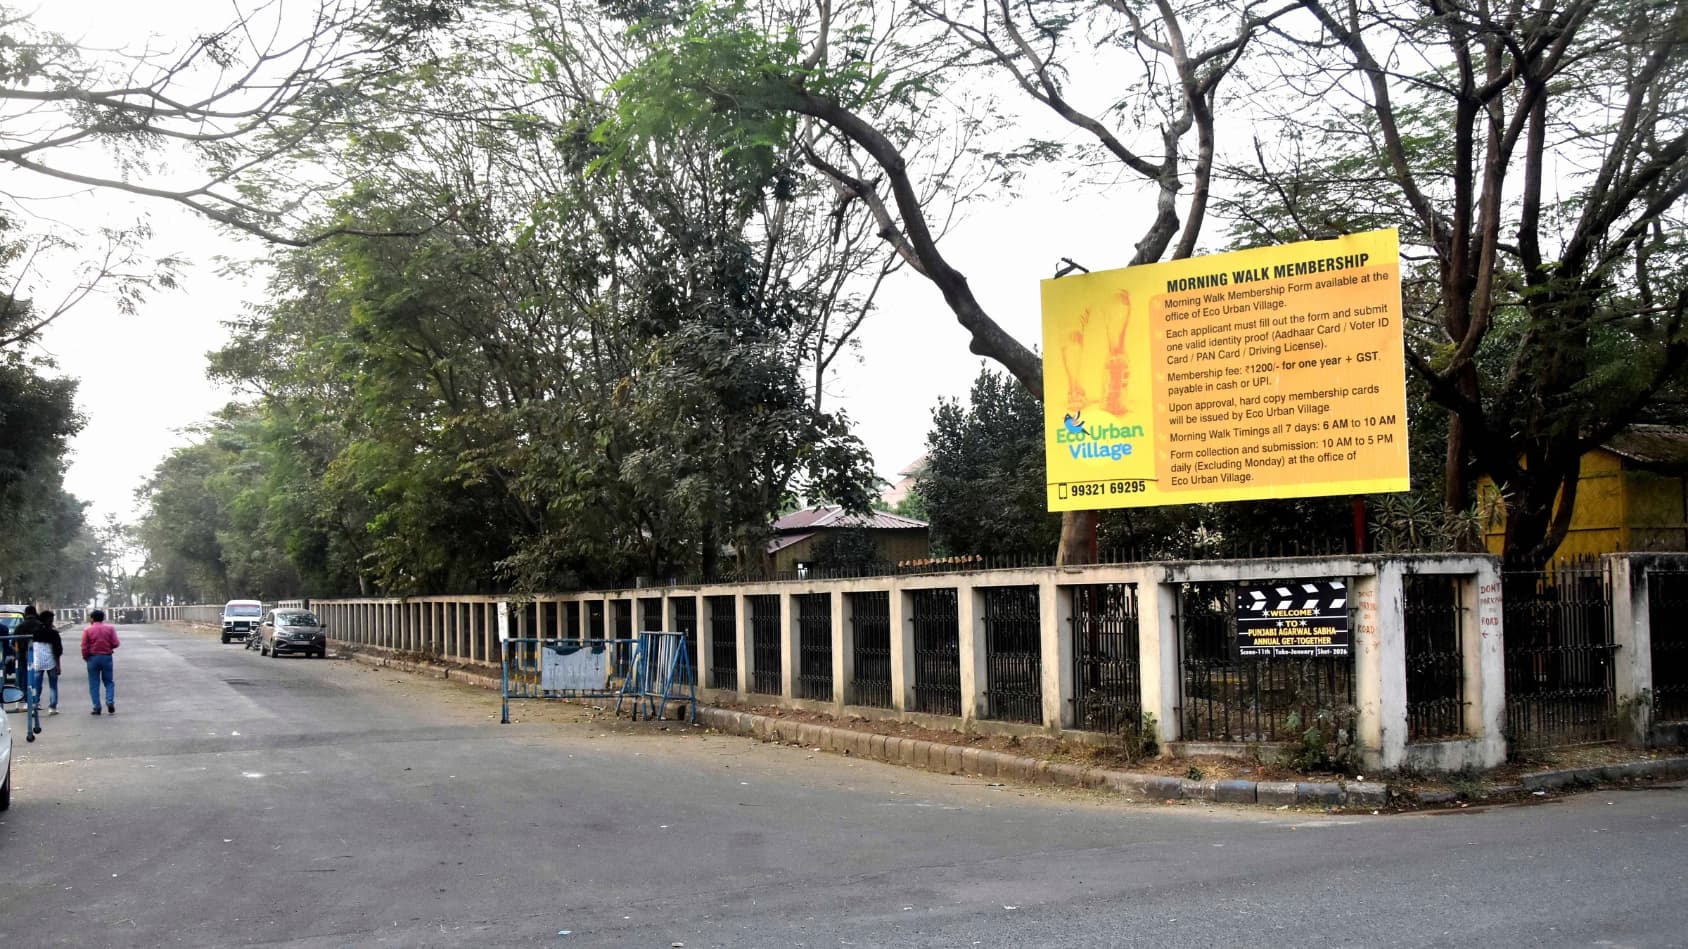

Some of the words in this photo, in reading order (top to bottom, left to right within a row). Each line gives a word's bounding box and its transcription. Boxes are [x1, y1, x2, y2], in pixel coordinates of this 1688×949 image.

[1167, 273, 1227, 292] MORNING
[1232, 268, 1270, 283] WALK
[1274, 253, 1369, 279] MEMBERSHIP
[1165, 295, 1201, 309] Morning
[1203, 292, 1225, 302] Walk
[1228, 285, 1285, 300] Membership
[1288, 281, 1312, 292] Form
[1315, 275, 1358, 289] available
[1361, 274, 1370, 283] at
[1373, 272, 1388, 281] the
[1165, 311, 1189, 322] office
[1192, 309, 1201, 318] of
[1203, 306, 1220, 317] Eco
[1222, 303, 1250, 314] Urban
[1253, 299, 1287, 310] Village.
[1166, 328, 1188, 339] Each
[1191, 324, 1231, 337] applicant
[1234, 321, 1256, 330] must
[1259, 318, 1270, 327] fill
[1273, 317, 1287, 326] out
[1290, 315, 1305, 324] the
[1307, 312, 1329, 321] form
[1332, 308, 1350, 318] and
[1354, 304, 1388, 316] submit
[1166, 342, 1183, 352] one
[1185, 338, 1206, 349] valid
[1209, 334, 1242, 348] identity
[1244, 331, 1269, 344] proof
[1272, 327, 1314, 341] (Aadhaar
[1317, 324, 1340, 334] Card
[1350, 321, 1375, 331] Voter
[1379, 318, 1389, 328] ID
[1167, 354, 1188, 365] Card
[1196, 351, 1215, 361] PAN
[1218, 348, 1240, 359] Card
[1249, 344, 1281, 356] Driving
[1284, 340, 1326, 352] License).
[1168, 369, 1222, 382] Membership
[1225, 367, 1242, 376] fee:
[1282, 361, 1296, 370] for
[1299, 359, 1317, 368] one
[1320, 356, 1341, 368] year
[1168, 384, 1203, 396] payable
[1205, 383, 1213, 392] in
[1216, 381, 1237, 390] cash
[1241, 380, 1250, 388] or
[1169, 402, 1193, 414] Upon
[1195, 399, 1237, 412] approval,
[1240, 396, 1260, 406] hard
[1263, 395, 1286, 405] copy
[1289, 389, 1349, 402] membership
[1352, 385, 1379, 395] cards
[1169, 416, 1183, 425] will
[1186, 414, 1197, 423] be
[1200, 412, 1229, 423] issued
[1232, 411, 1243, 421] by
[1246, 409, 1263, 419] Eco
[1266, 406, 1295, 416] Urban
[1091, 424, 1144, 440] Urban
[1170, 431, 1206, 443] Morning
[1209, 429, 1231, 439] Walk
[1233, 425, 1270, 438] Timings
[1273, 424, 1283, 434] all
[1286, 424, 1291, 433] 7
[1294, 422, 1320, 434] days:
[1323, 421, 1329, 430] 6
[1332, 419, 1348, 429] AM
[1352, 419, 1361, 428] to
[1364, 418, 1376, 427] 10
[1379, 415, 1396, 425] AM
[1069, 442, 1131, 460] Village
[1170, 449, 1193, 459] Form
[1196, 446, 1239, 457] collection
[1242, 445, 1259, 454] and
[1262, 441, 1318, 452] submission:
[1323, 439, 1333, 448] 10
[1336, 437, 1352, 447] AM
[1355, 437, 1364, 446] to
[1368, 436, 1374, 445] 5
[1377, 434, 1393, 443] PM
[1171, 462, 1191, 474] daily
[1195, 458, 1242, 471] (Excluding
[1245, 455, 1284, 467] Monday)
[1288, 456, 1297, 464] at
[1300, 454, 1315, 463] the
[1318, 451, 1344, 461] office
[1347, 451, 1356, 460] of
[1072, 484, 1104, 496] 99321
[1110, 481, 1145, 493] 69295
[1172, 476, 1188, 486] Eco
[1191, 474, 1218, 484] Urban
[1221, 472, 1254, 483] Village.
[1271, 609, 1313, 617] WELCOME
[1248, 628, 1277, 636] PUNJABI
[1279, 628, 1312, 636] AGARWAL
[1314, 627, 1336, 635] SABHA
[1254, 637, 1280, 645] ANNUAL
[1282, 637, 1331, 645] GET-TOGETHER
